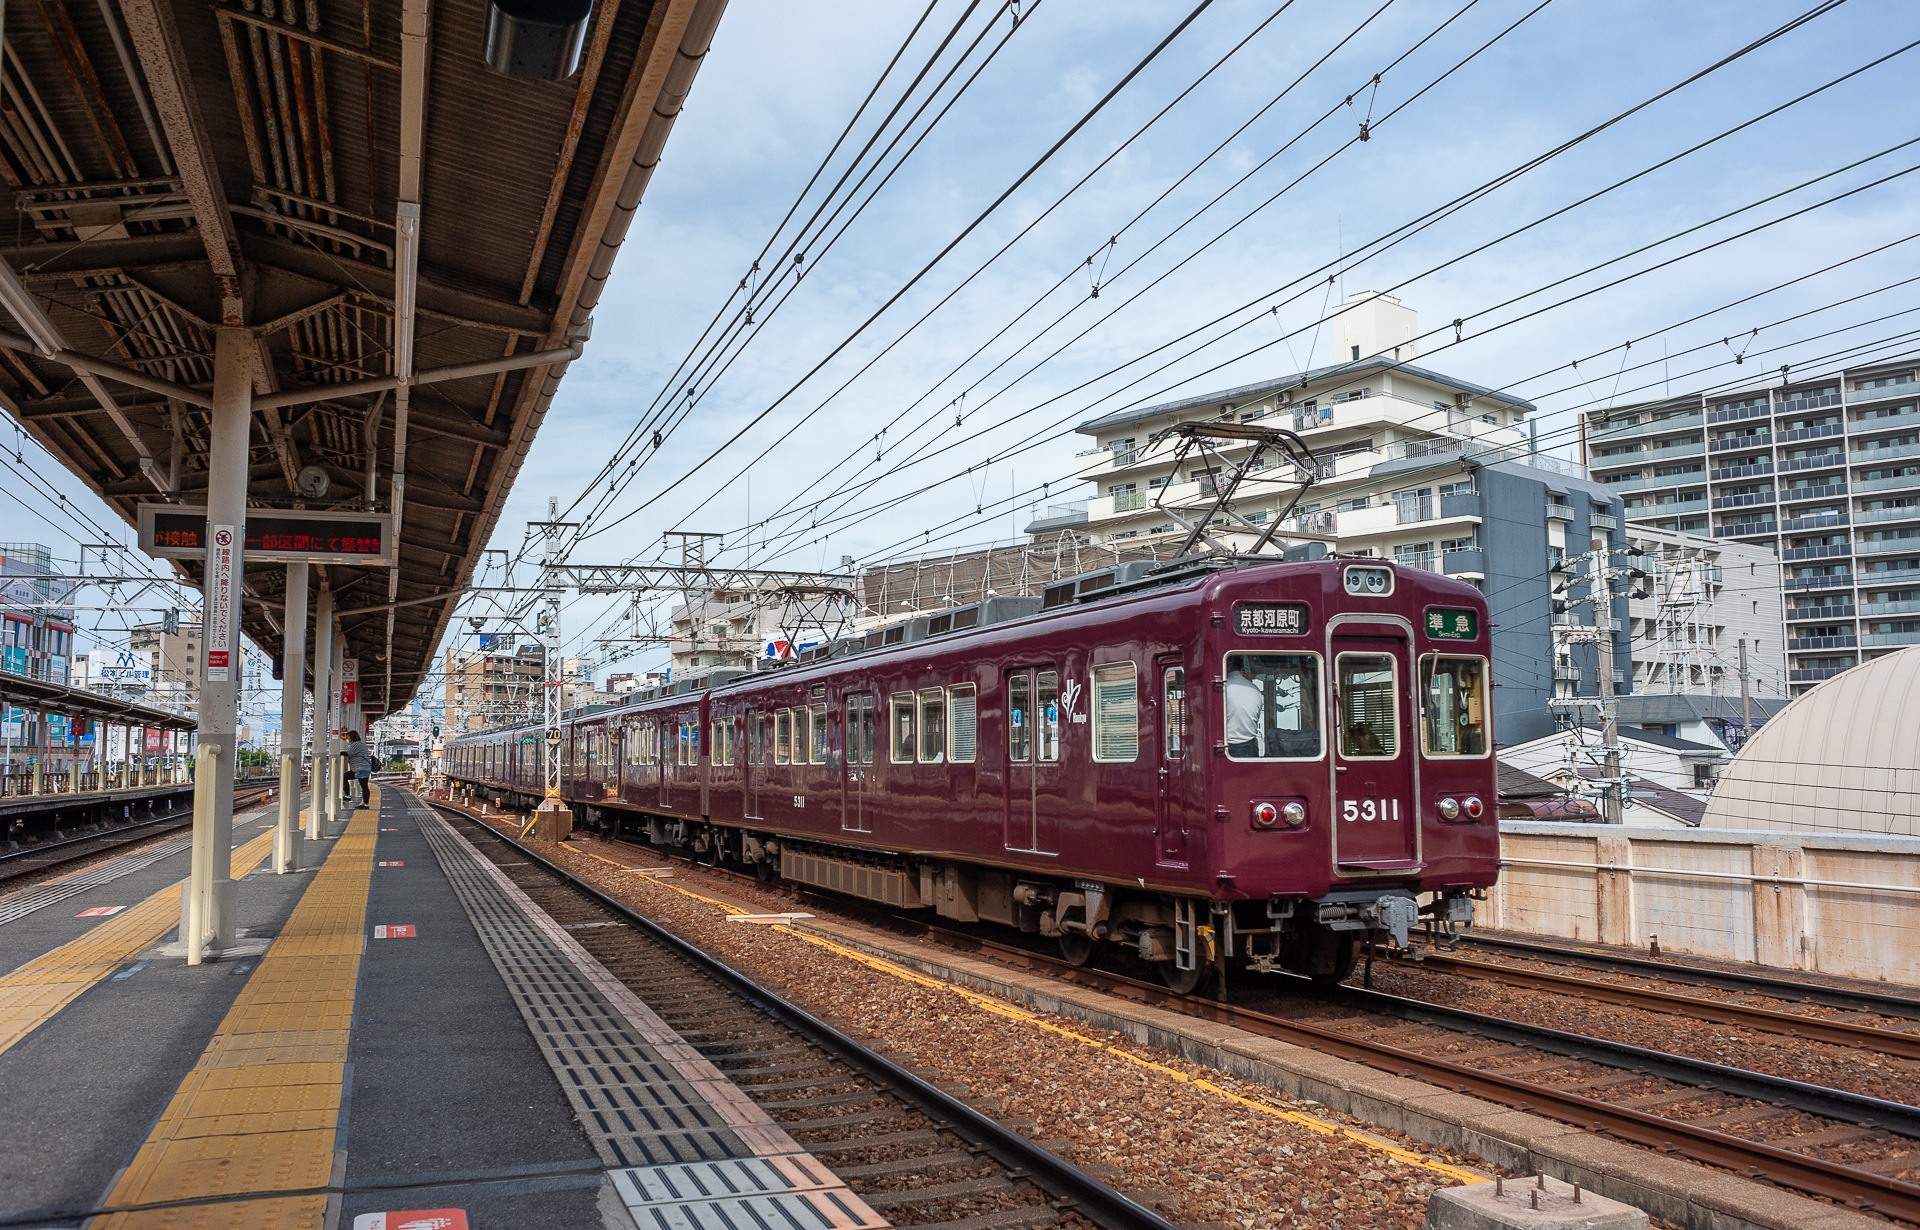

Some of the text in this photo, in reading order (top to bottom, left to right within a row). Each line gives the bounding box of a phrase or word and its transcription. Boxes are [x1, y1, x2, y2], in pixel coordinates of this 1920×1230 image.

[218, 548, 231, 648] 線路内へ降りないでください
[1240, 609, 1300, 627] 京都河原町
[1428, 613, 1470, 632] 準急
[547, 729, 561, 739] 70
[793, 795, 805, 809] 5311
[1342, 798, 1399, 822] 5311
